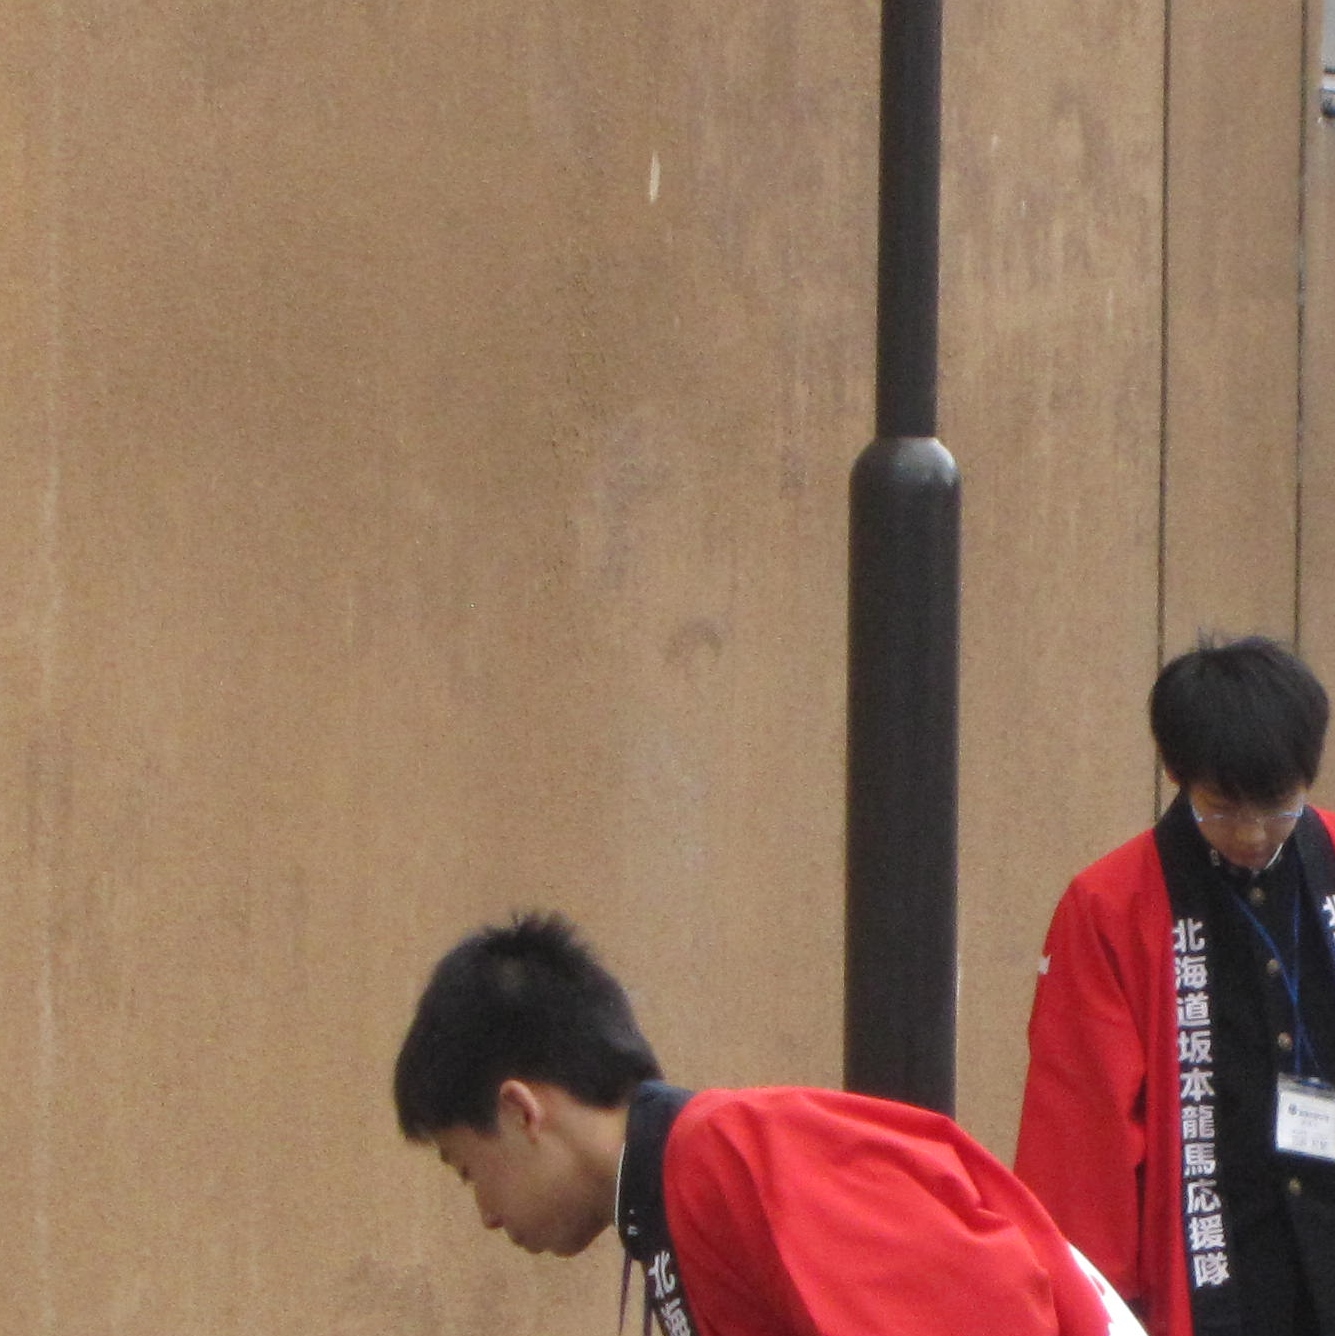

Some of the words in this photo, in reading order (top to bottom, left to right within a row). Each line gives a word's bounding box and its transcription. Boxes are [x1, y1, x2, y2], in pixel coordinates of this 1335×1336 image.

[1171, 917, 1231, 1288] 北海道坂本龍馬応援隊
